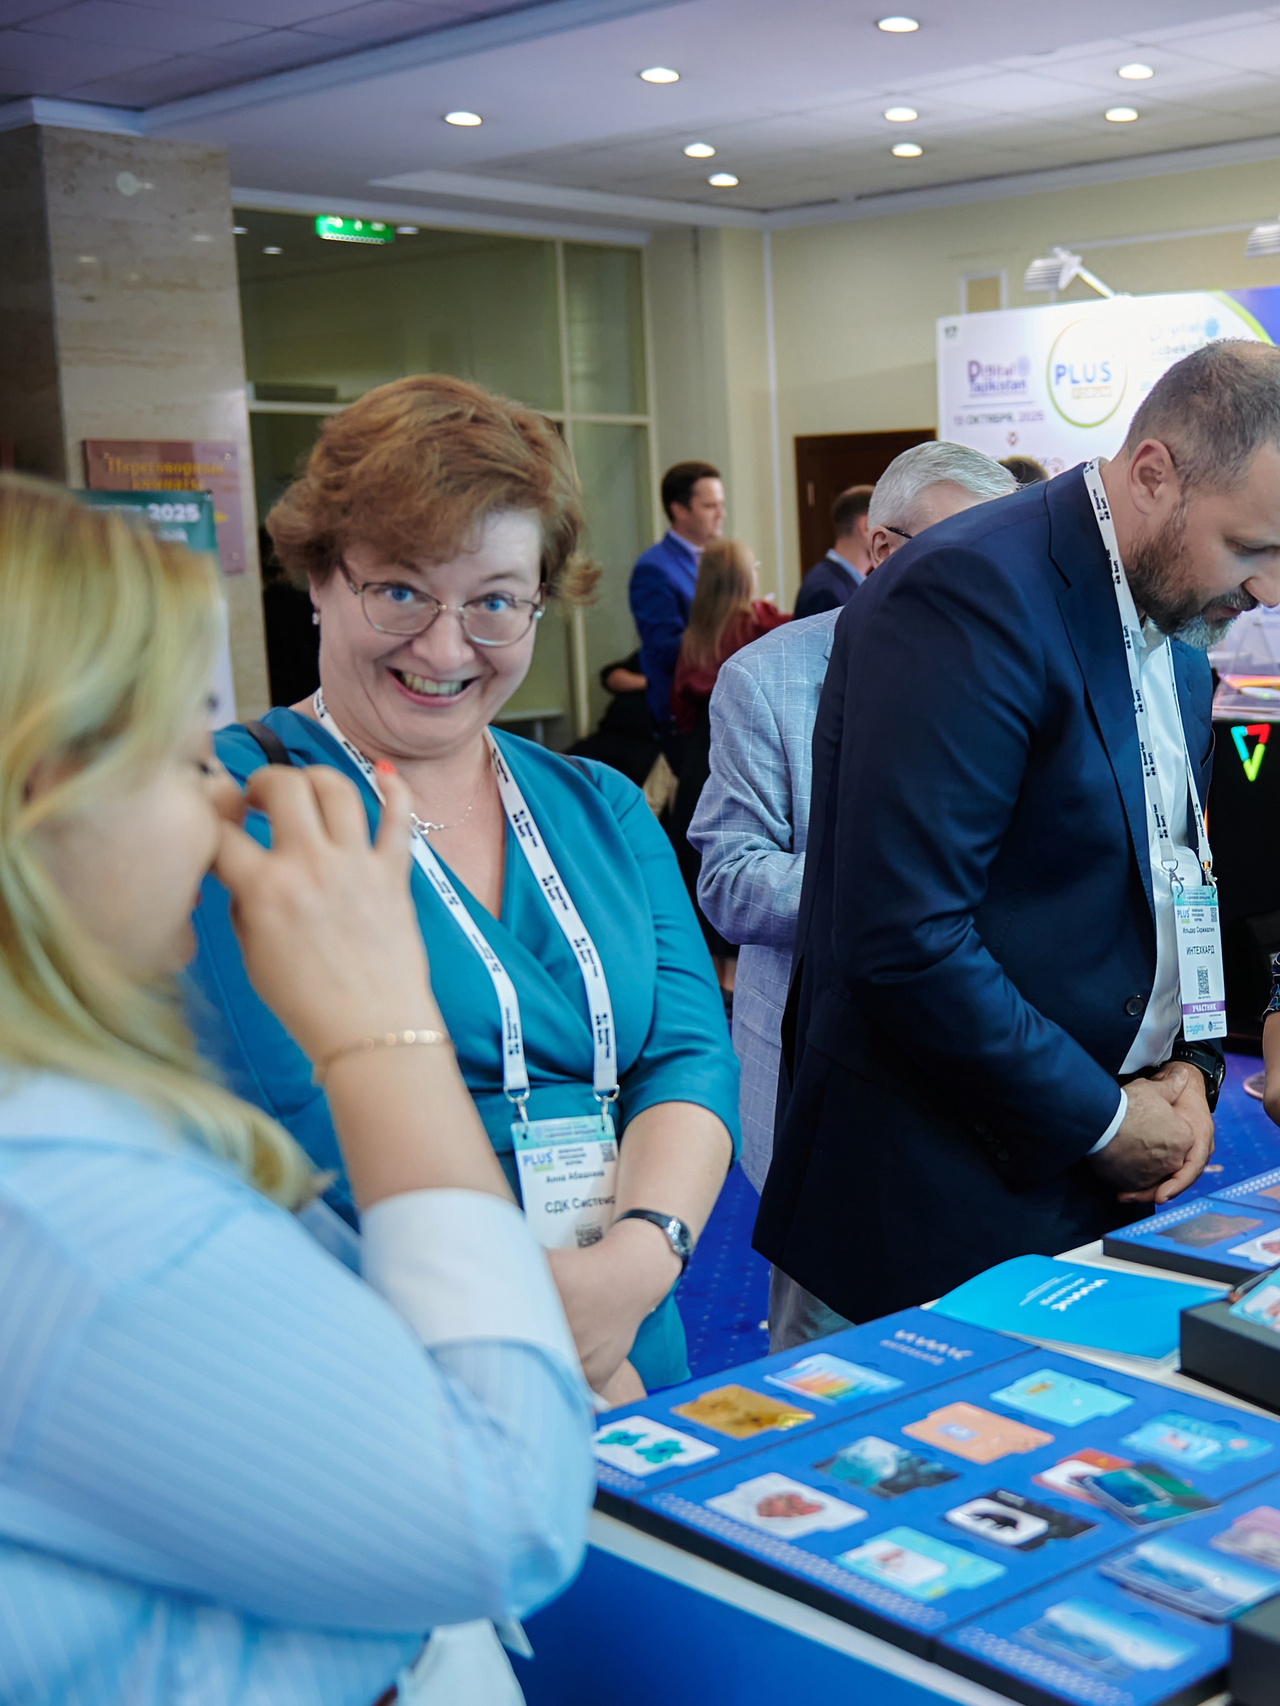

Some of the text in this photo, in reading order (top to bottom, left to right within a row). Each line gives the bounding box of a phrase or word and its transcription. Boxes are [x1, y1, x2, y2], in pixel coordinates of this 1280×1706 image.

[1055, 361, 1111, 386] PLUS
[147, 502, 200, 523] 2025
[1186, 945, 1215, 956] ИНТЕХКАРД
[523, 1152, 553, 1167] PLUS
[545, 1199, 570, 1214] СДК
